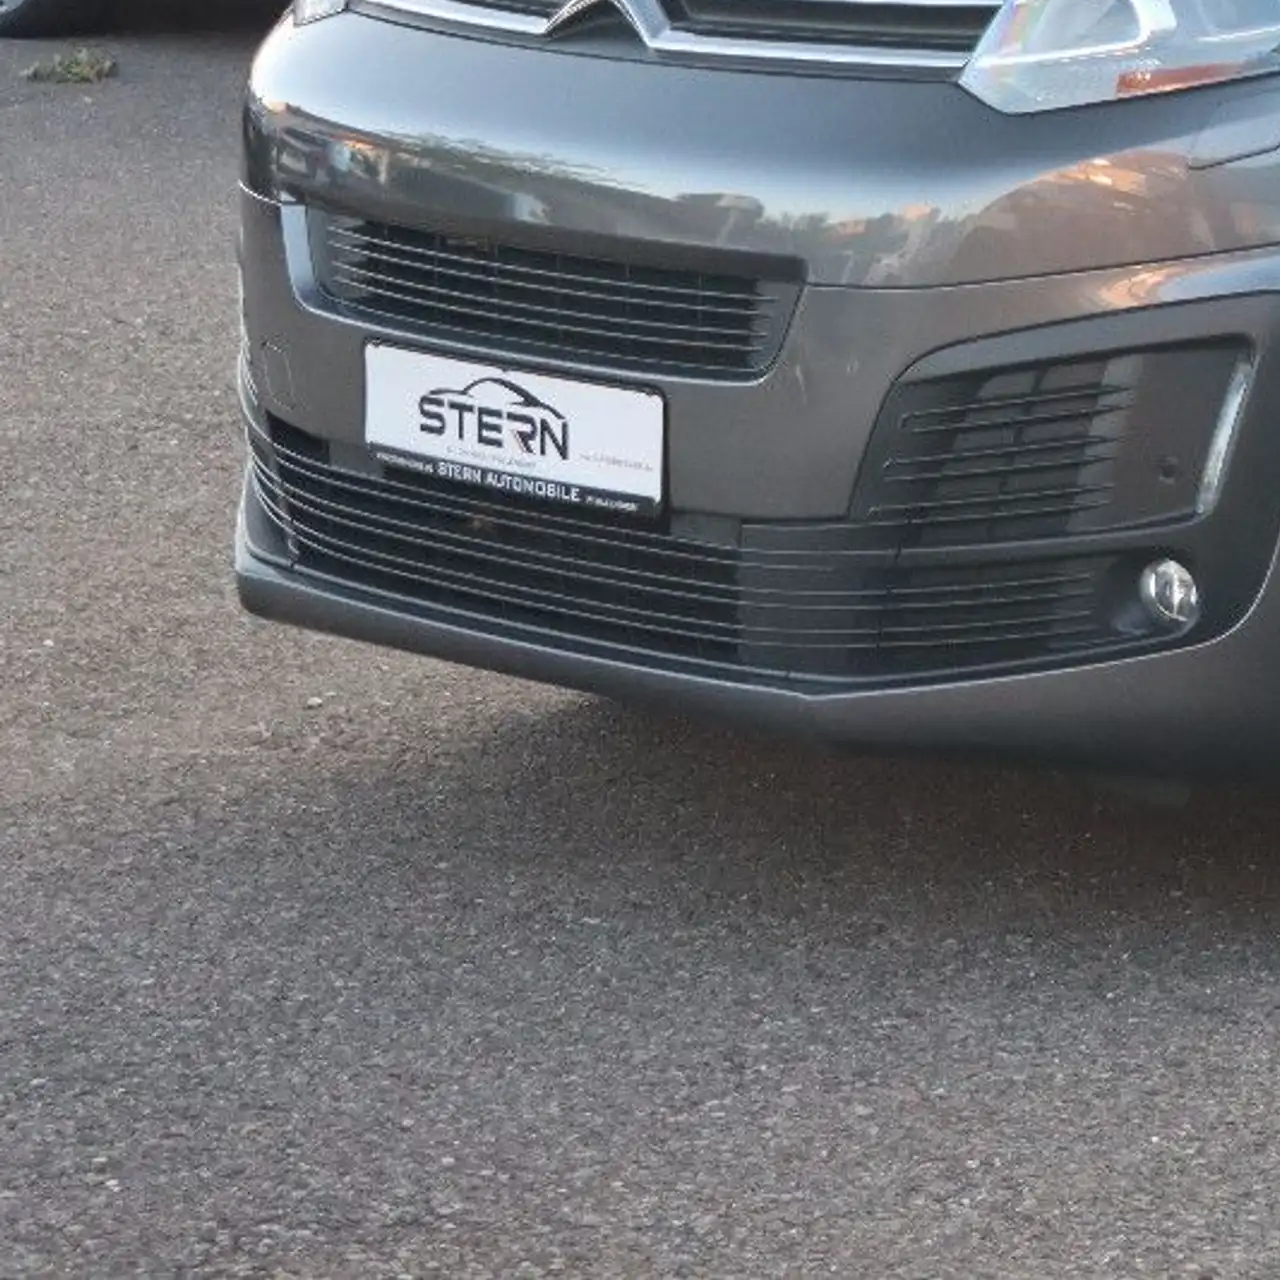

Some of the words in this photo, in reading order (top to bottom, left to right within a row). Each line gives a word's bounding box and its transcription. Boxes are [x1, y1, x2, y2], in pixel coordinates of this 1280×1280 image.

[418, 394, 570, 461] STERN
[437, 460, 482, 484] STERN
[486, 470, 581, 502] AUTOMOBILE
